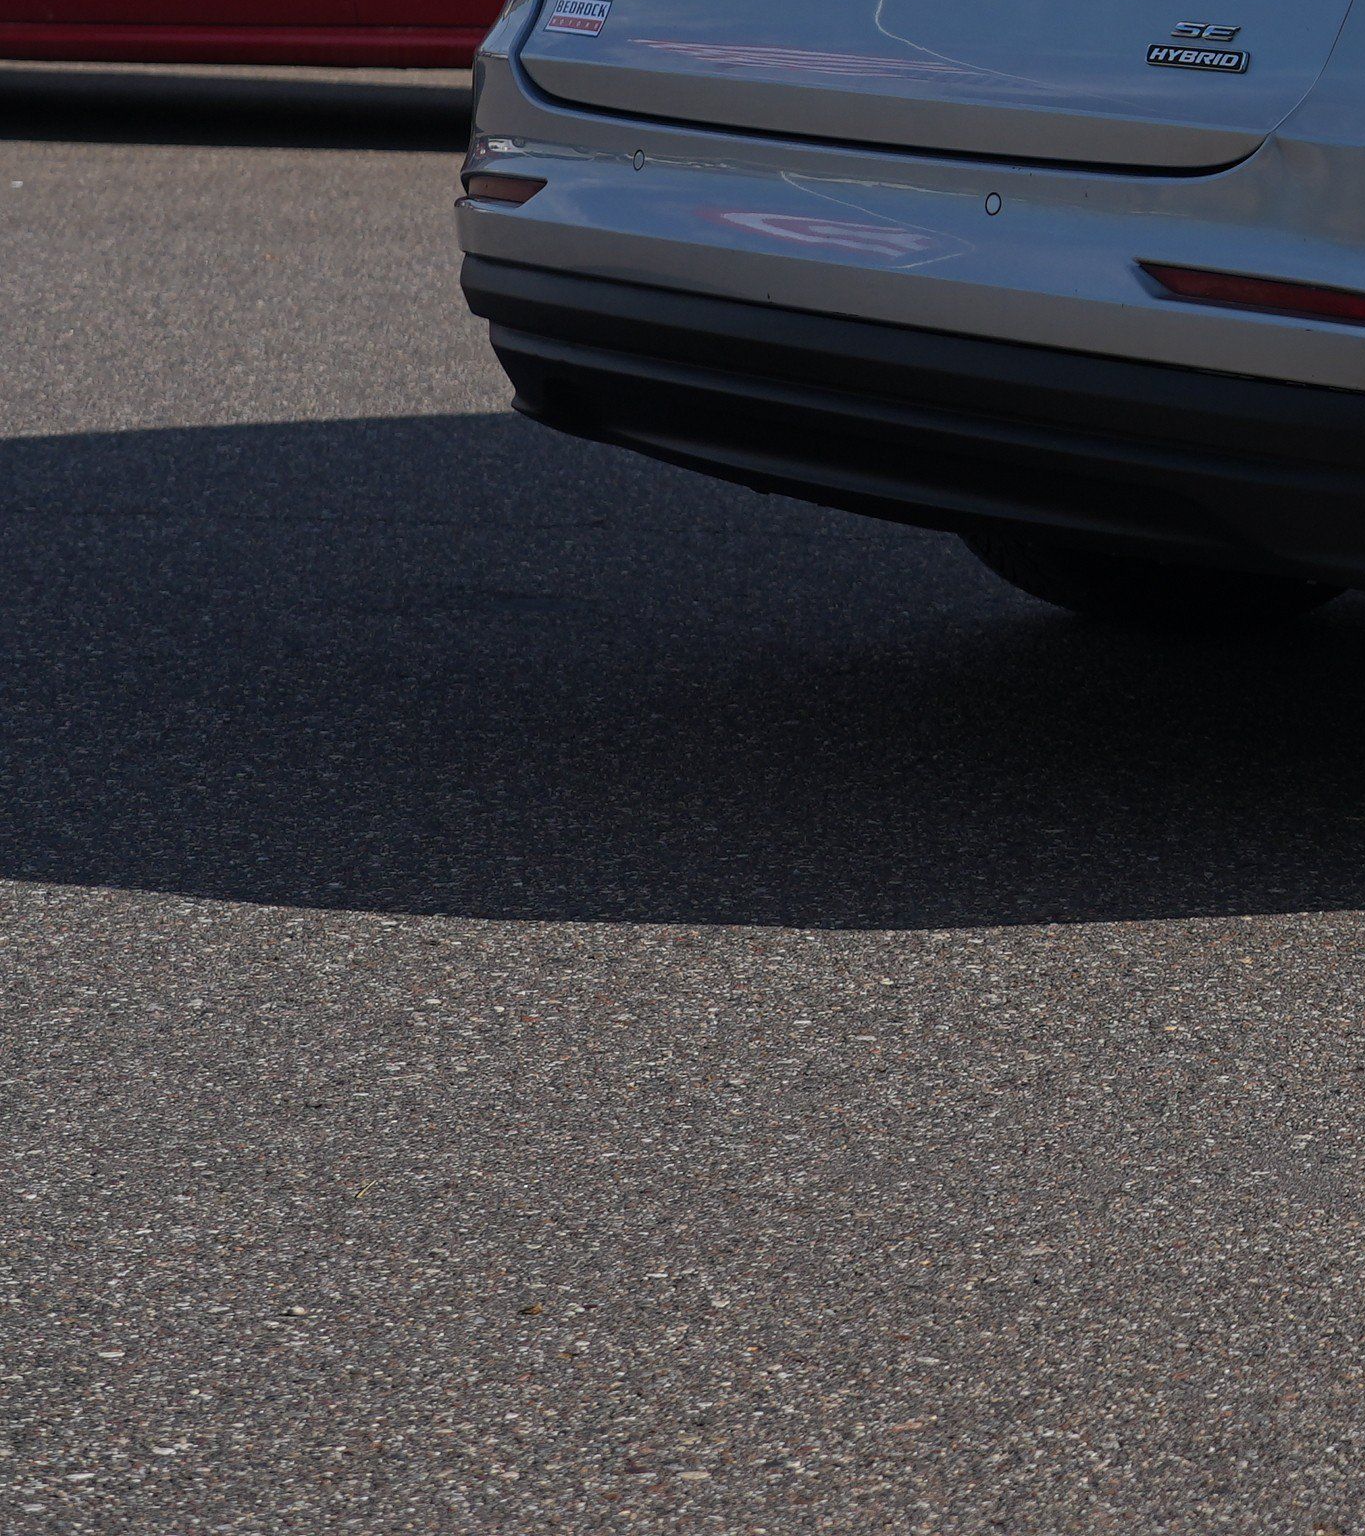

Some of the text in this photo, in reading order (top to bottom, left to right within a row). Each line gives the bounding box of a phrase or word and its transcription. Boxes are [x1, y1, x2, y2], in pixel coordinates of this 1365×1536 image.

[555, 0, 609, 18] BEDROCK
[1171, 21, 1242, 42] SE
[1149, 47, 1239, 67] HYBRID
